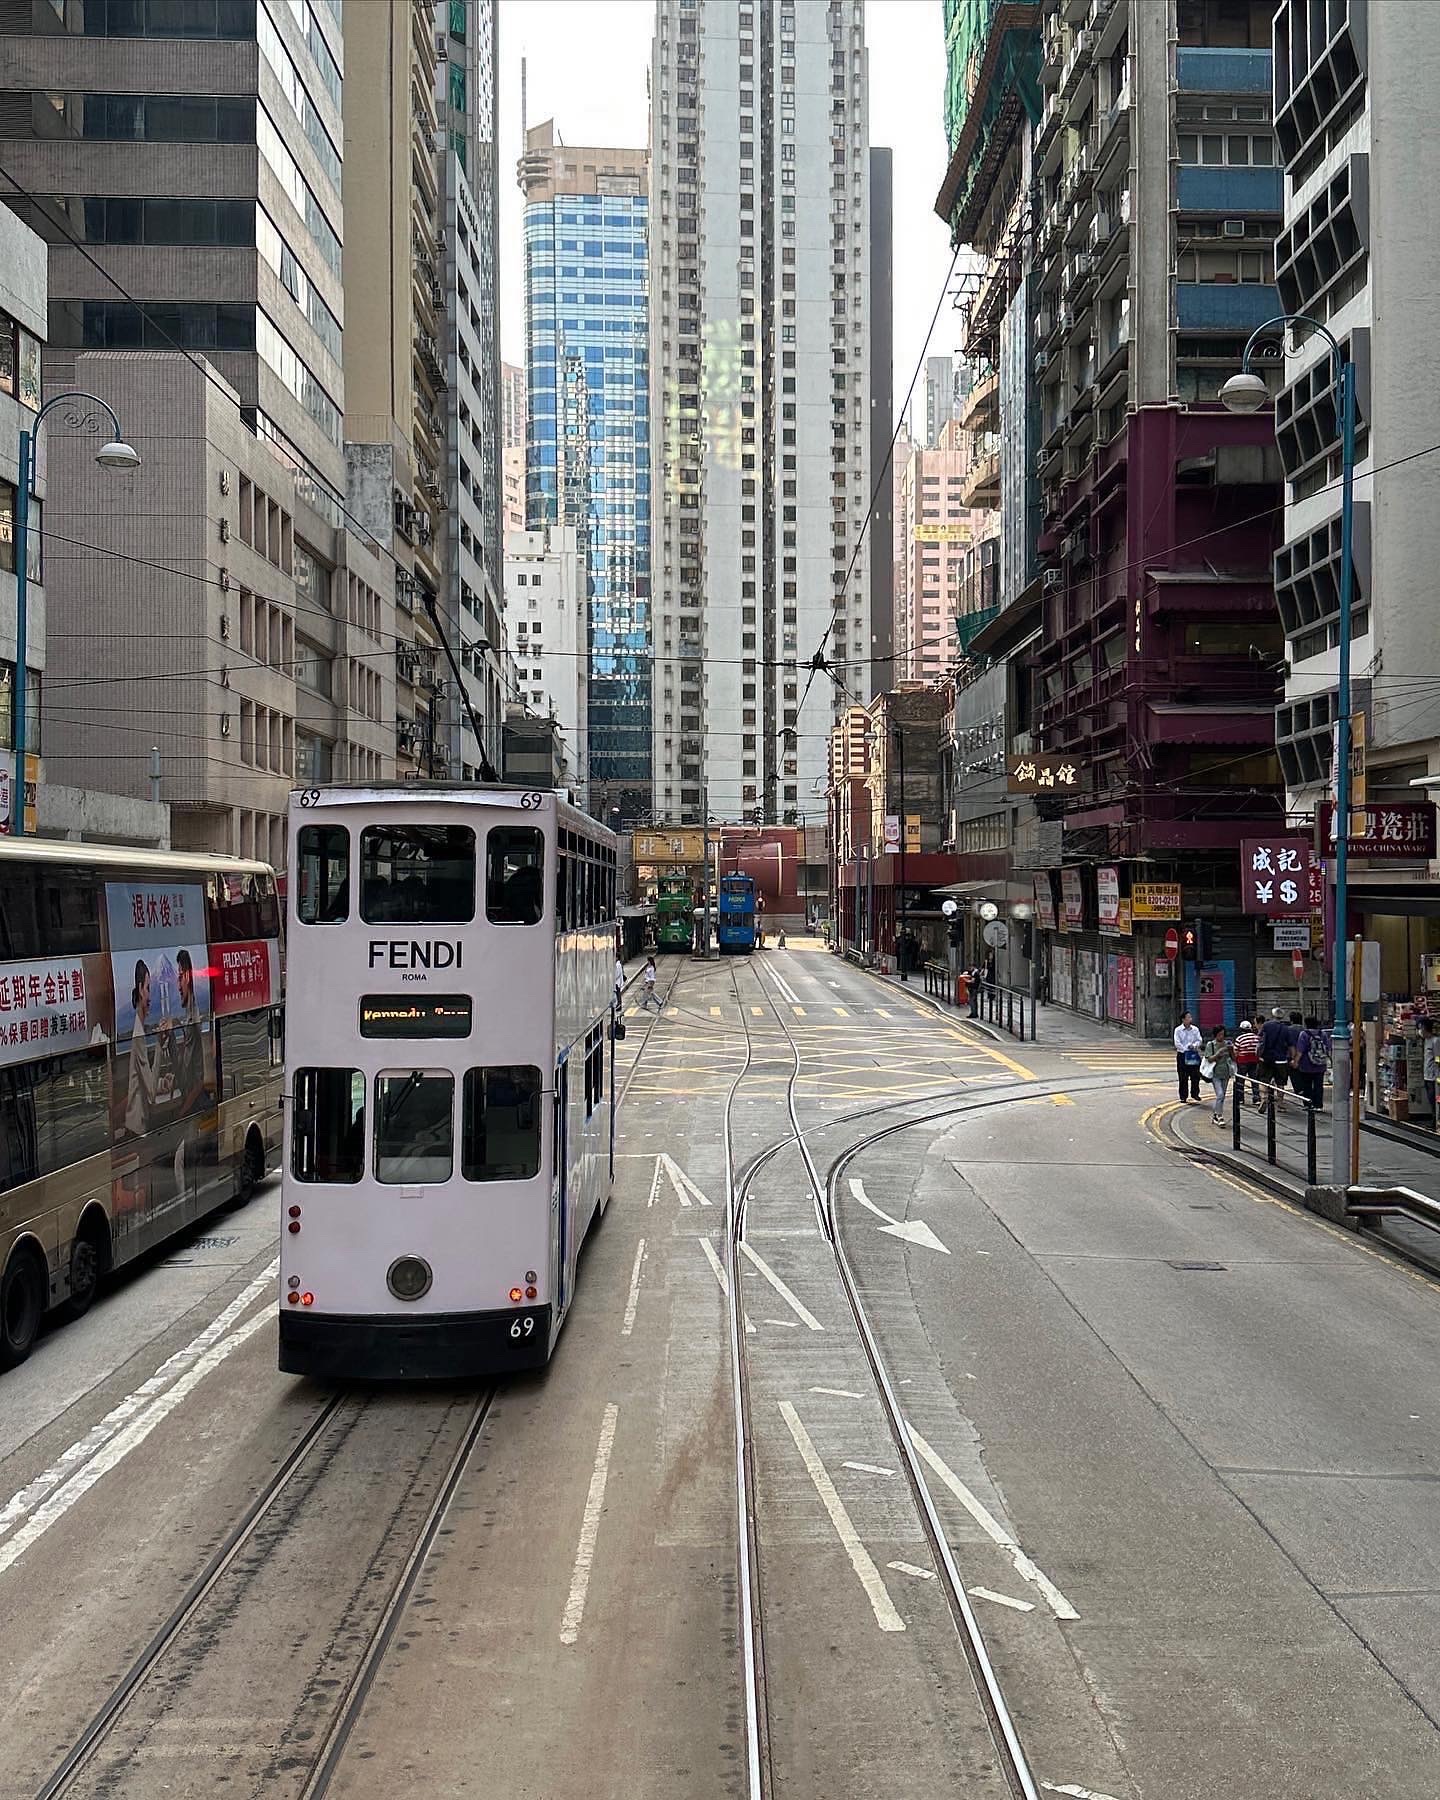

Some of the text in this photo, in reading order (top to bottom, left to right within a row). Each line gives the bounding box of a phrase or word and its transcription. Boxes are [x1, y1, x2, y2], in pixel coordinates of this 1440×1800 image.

[300, 789, 321, 807] 69
[520, 792, 542, 810] 69
[1373, 843, 1401, 852] CHINA
[1252, 846, 1302, 875] 成記
[132, 894, 172, 928] 退休後
[368, 940, 463, 969] FENDI
[510, 1316, 534, 1337] 69
